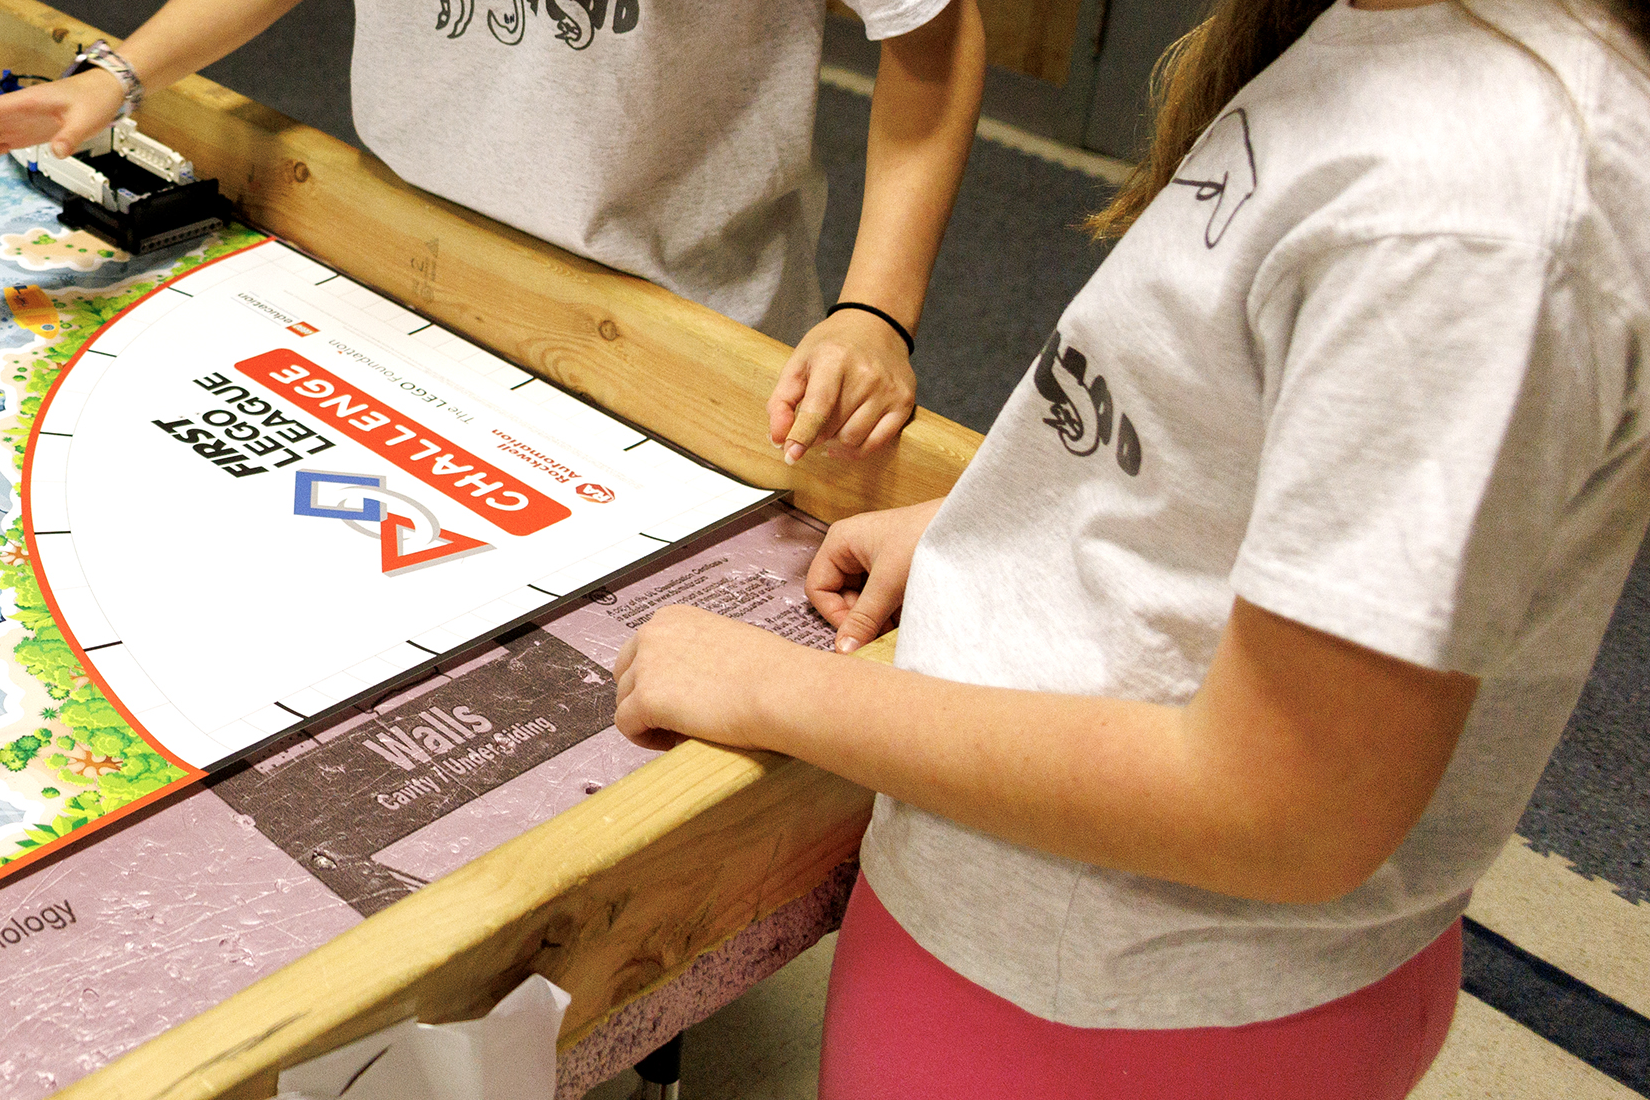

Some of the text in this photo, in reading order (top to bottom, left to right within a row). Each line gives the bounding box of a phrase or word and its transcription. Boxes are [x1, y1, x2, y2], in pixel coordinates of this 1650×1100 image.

[237, 291, 293, 324] education
[328, 338, 403, 383] Foundation
[192, 371, 337, 455] LEAGUE
[399, 381, 447, 408] LEGO
[448, 406, 475, 425] The
[151, 418, 270, 479] FIRST
[201, 409, 304, 469] LEGO
[268, 364, 530, 512] CHALLENGE
[491, 428, 583, 480] Automation
[496, 442, 571, 484] Rockwell
[362, 705, 493, 771] Walls
[377, 775, 441, 811] Cavity
[442, 743, 500, 775] Under
